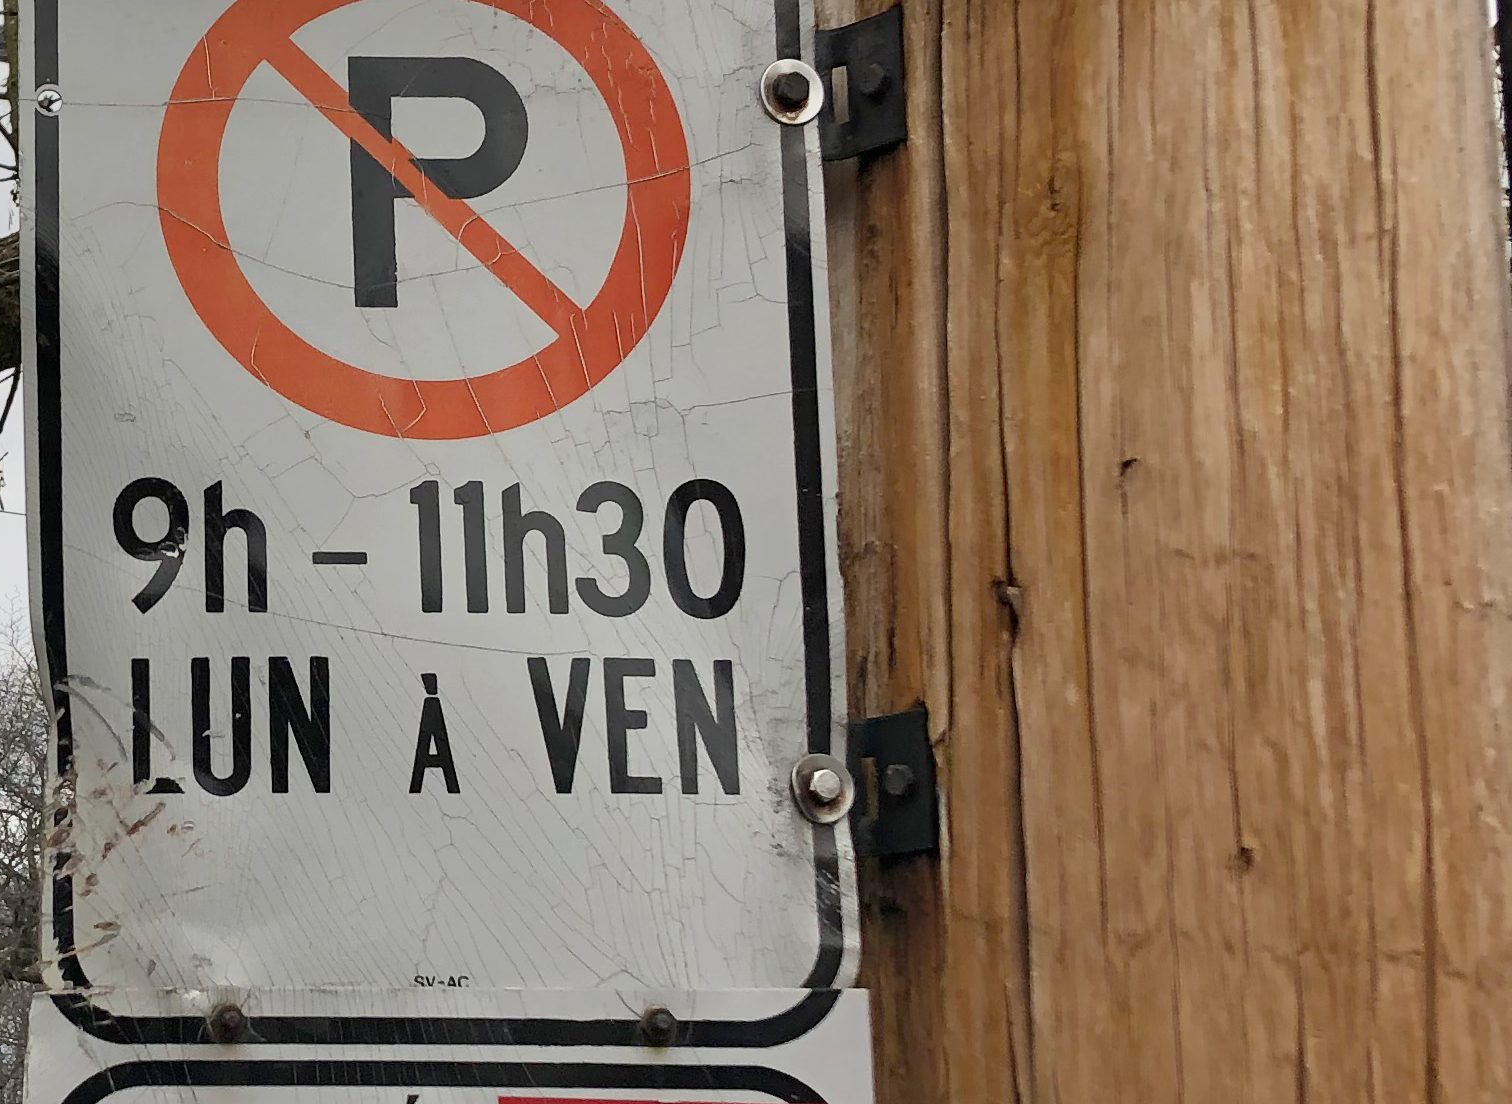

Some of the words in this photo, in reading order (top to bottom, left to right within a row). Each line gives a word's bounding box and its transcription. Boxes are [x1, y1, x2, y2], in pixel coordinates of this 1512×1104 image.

[348, 56, 529, 308] P
[112, 476, 269, 615] 9h
[409, 478, 746, 621] 11h30
[131, 656, 331, 794] LUN
[409, 672, 461, 794] À
[526, 656, 741, 795] VEN
